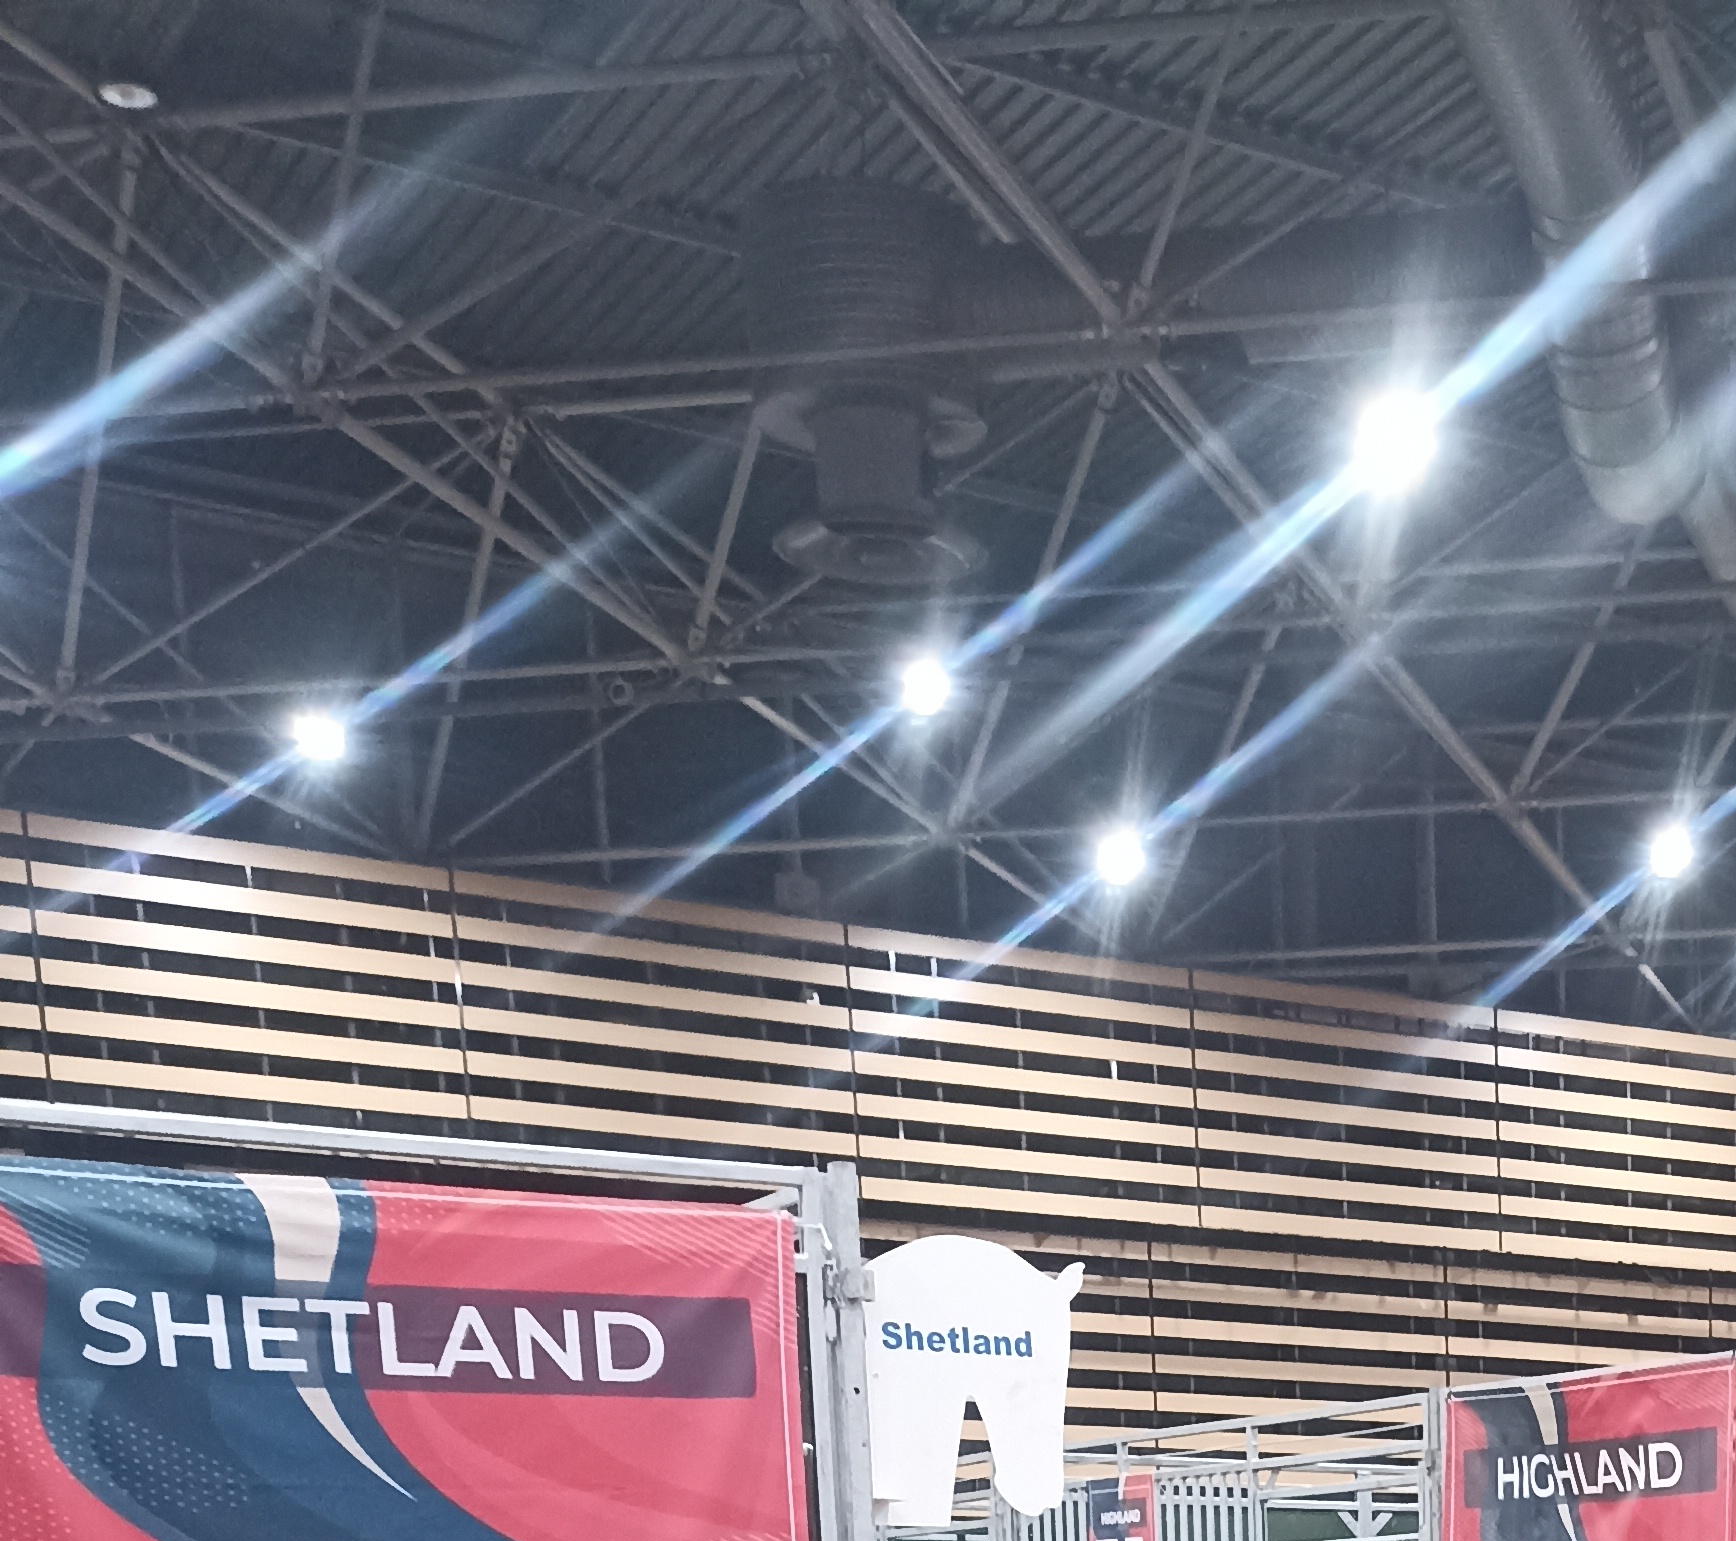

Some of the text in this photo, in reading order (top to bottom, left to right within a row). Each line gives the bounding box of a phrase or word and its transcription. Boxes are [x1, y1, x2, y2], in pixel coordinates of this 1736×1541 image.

[79, 1287, 666, 1383] SHETLAND
[881, 1322, 1033, 1358] Shetland
[1497, 1442, 1683, 1500] HIGHLAND
